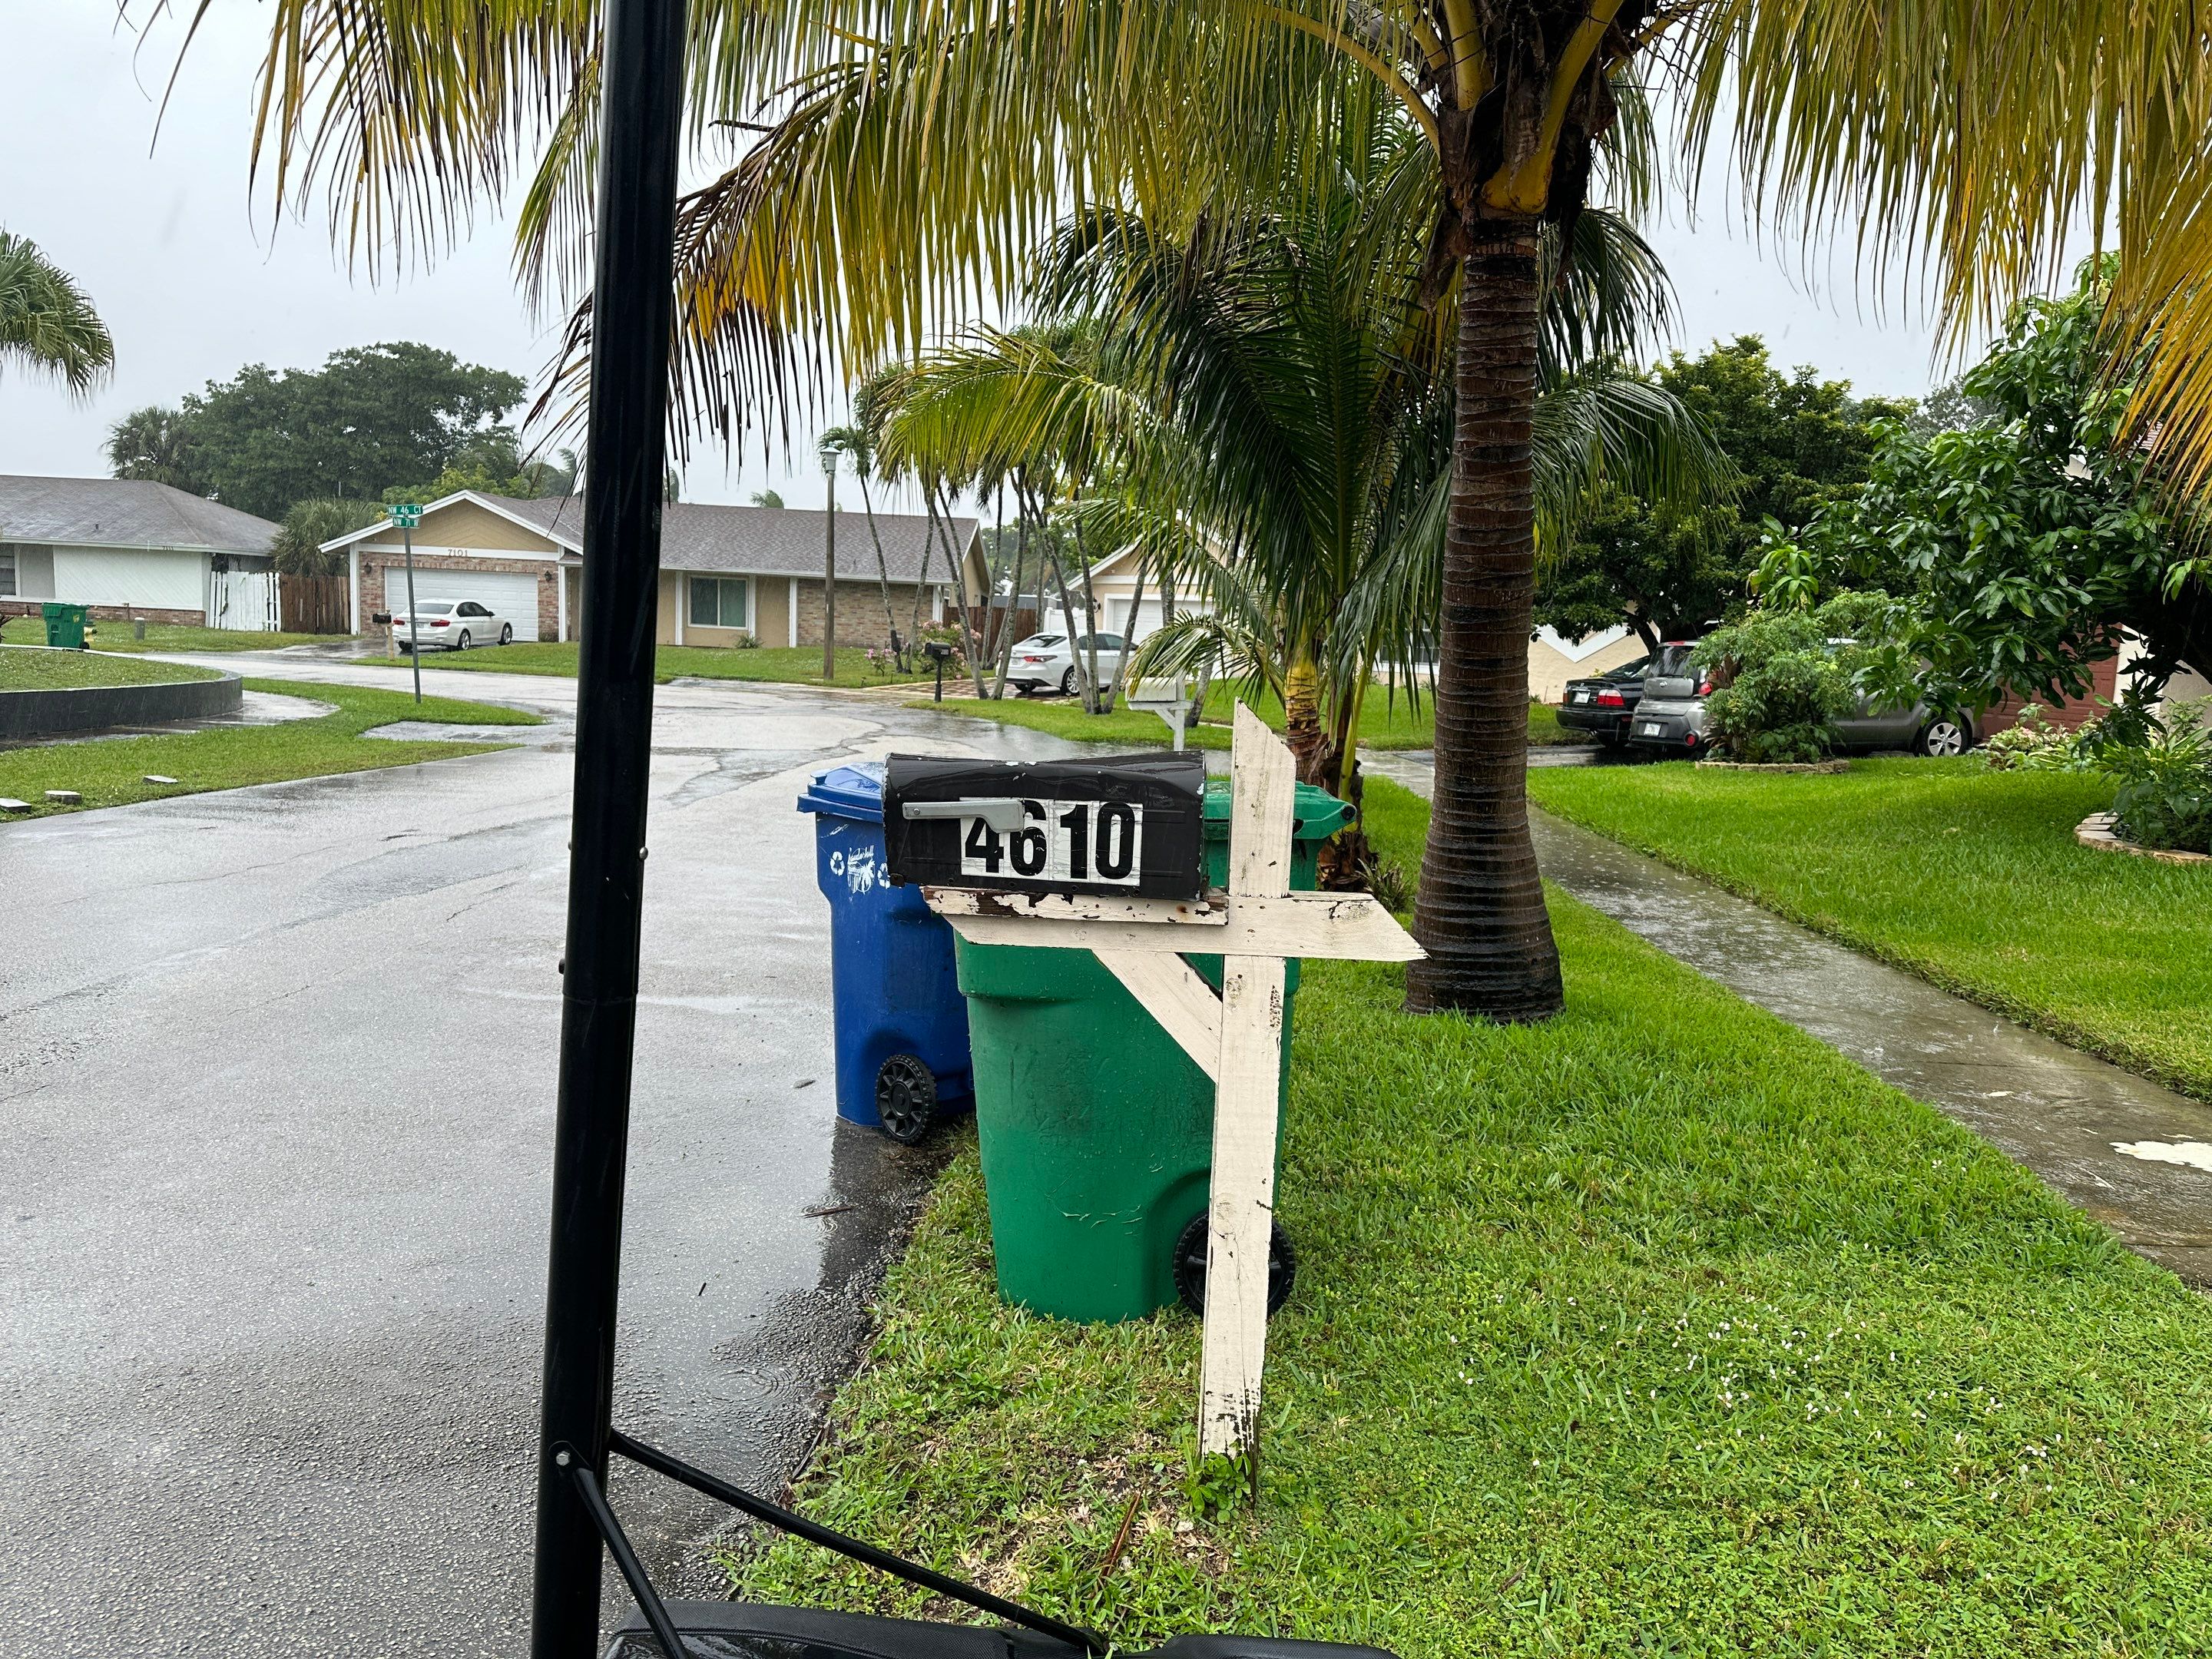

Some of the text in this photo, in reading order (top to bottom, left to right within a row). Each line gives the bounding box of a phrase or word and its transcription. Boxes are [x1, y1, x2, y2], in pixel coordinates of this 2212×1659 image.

[413, 505, 422, 514] CT
[393, 517, 402, 525] NW
[405, 518, 410, 526] 71
[448, 548, 469, 557] 7101
[965, 800, 1135, 880] 4610
